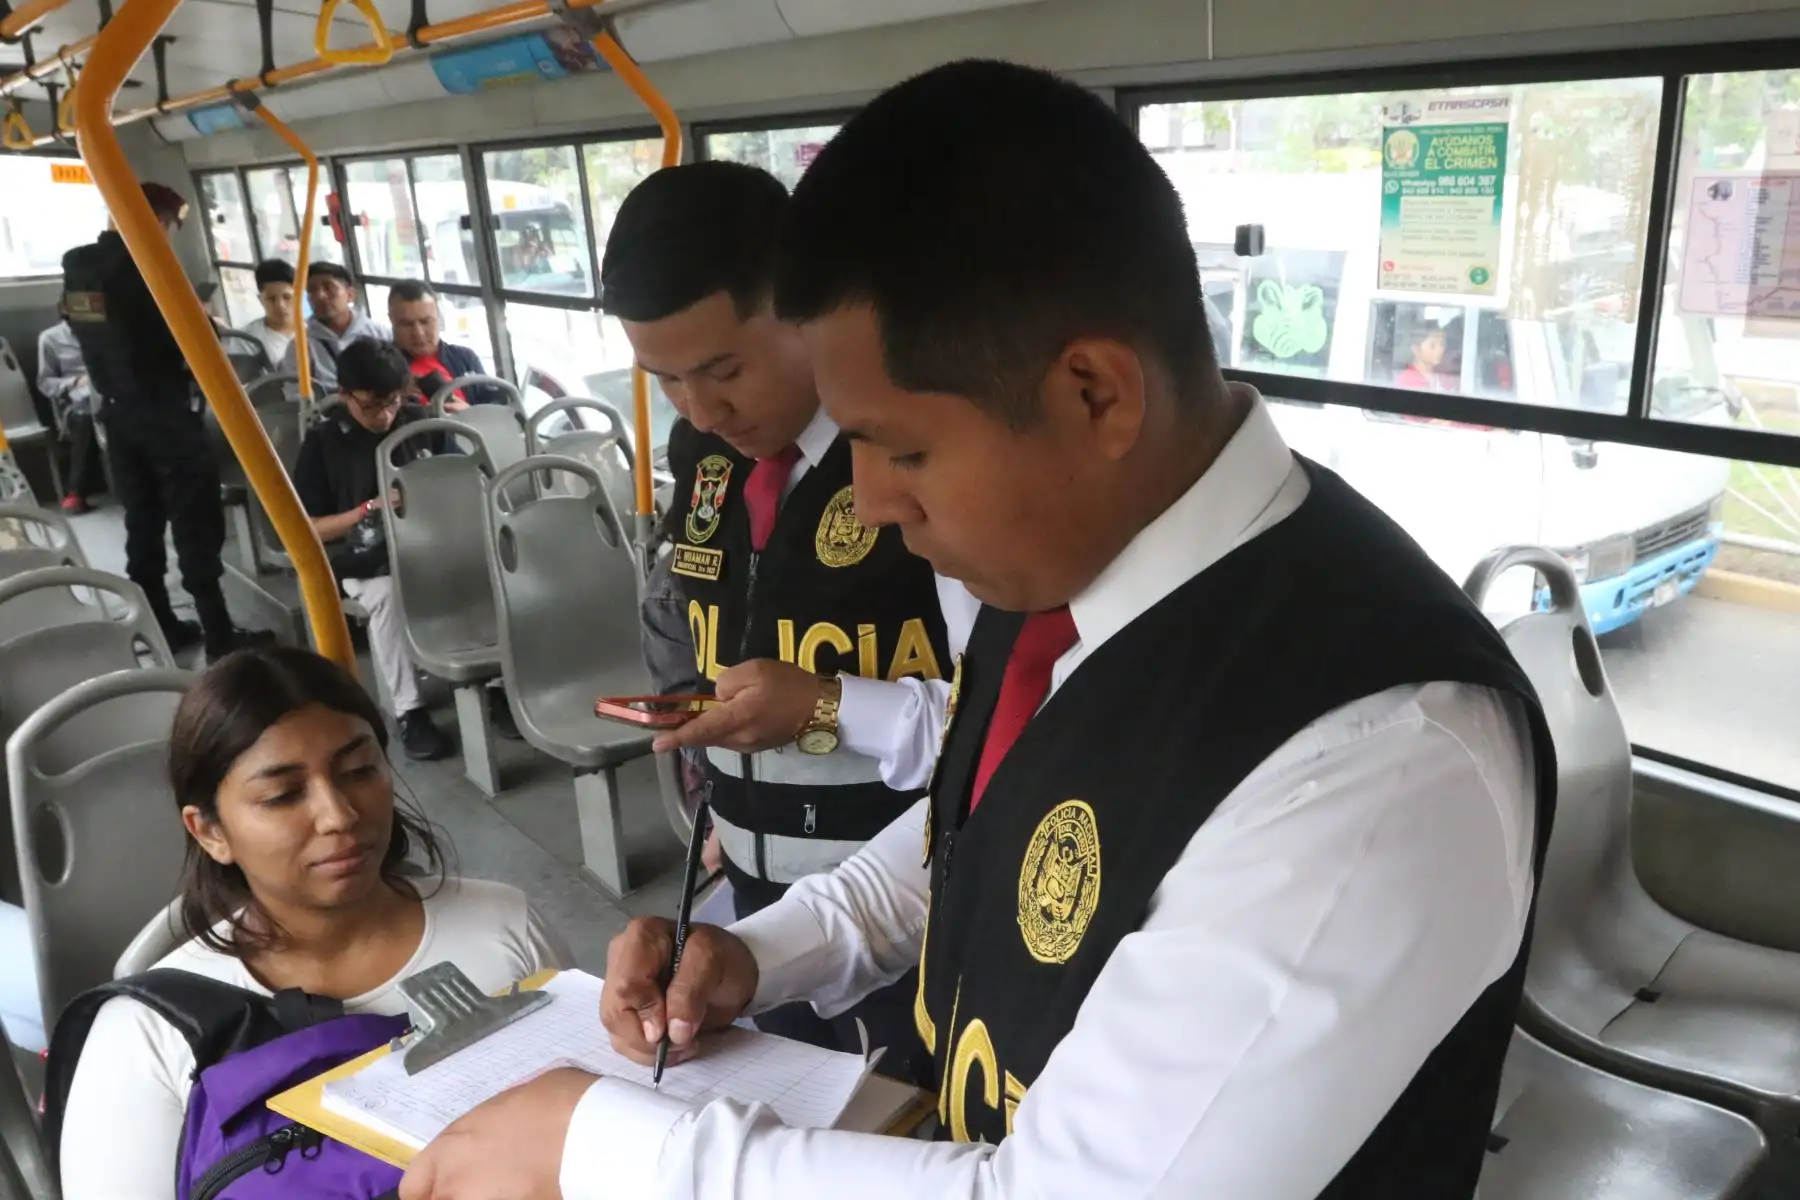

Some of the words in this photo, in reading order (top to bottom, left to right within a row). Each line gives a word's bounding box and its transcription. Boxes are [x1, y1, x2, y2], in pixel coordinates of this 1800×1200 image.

[1427, 147, 1437, 158] A
[1437, 145, 1496, 158] COMBATIR
[1425, 158, 1441, 170] EL
[1444, 156, 1498, 169] CRIMEN
